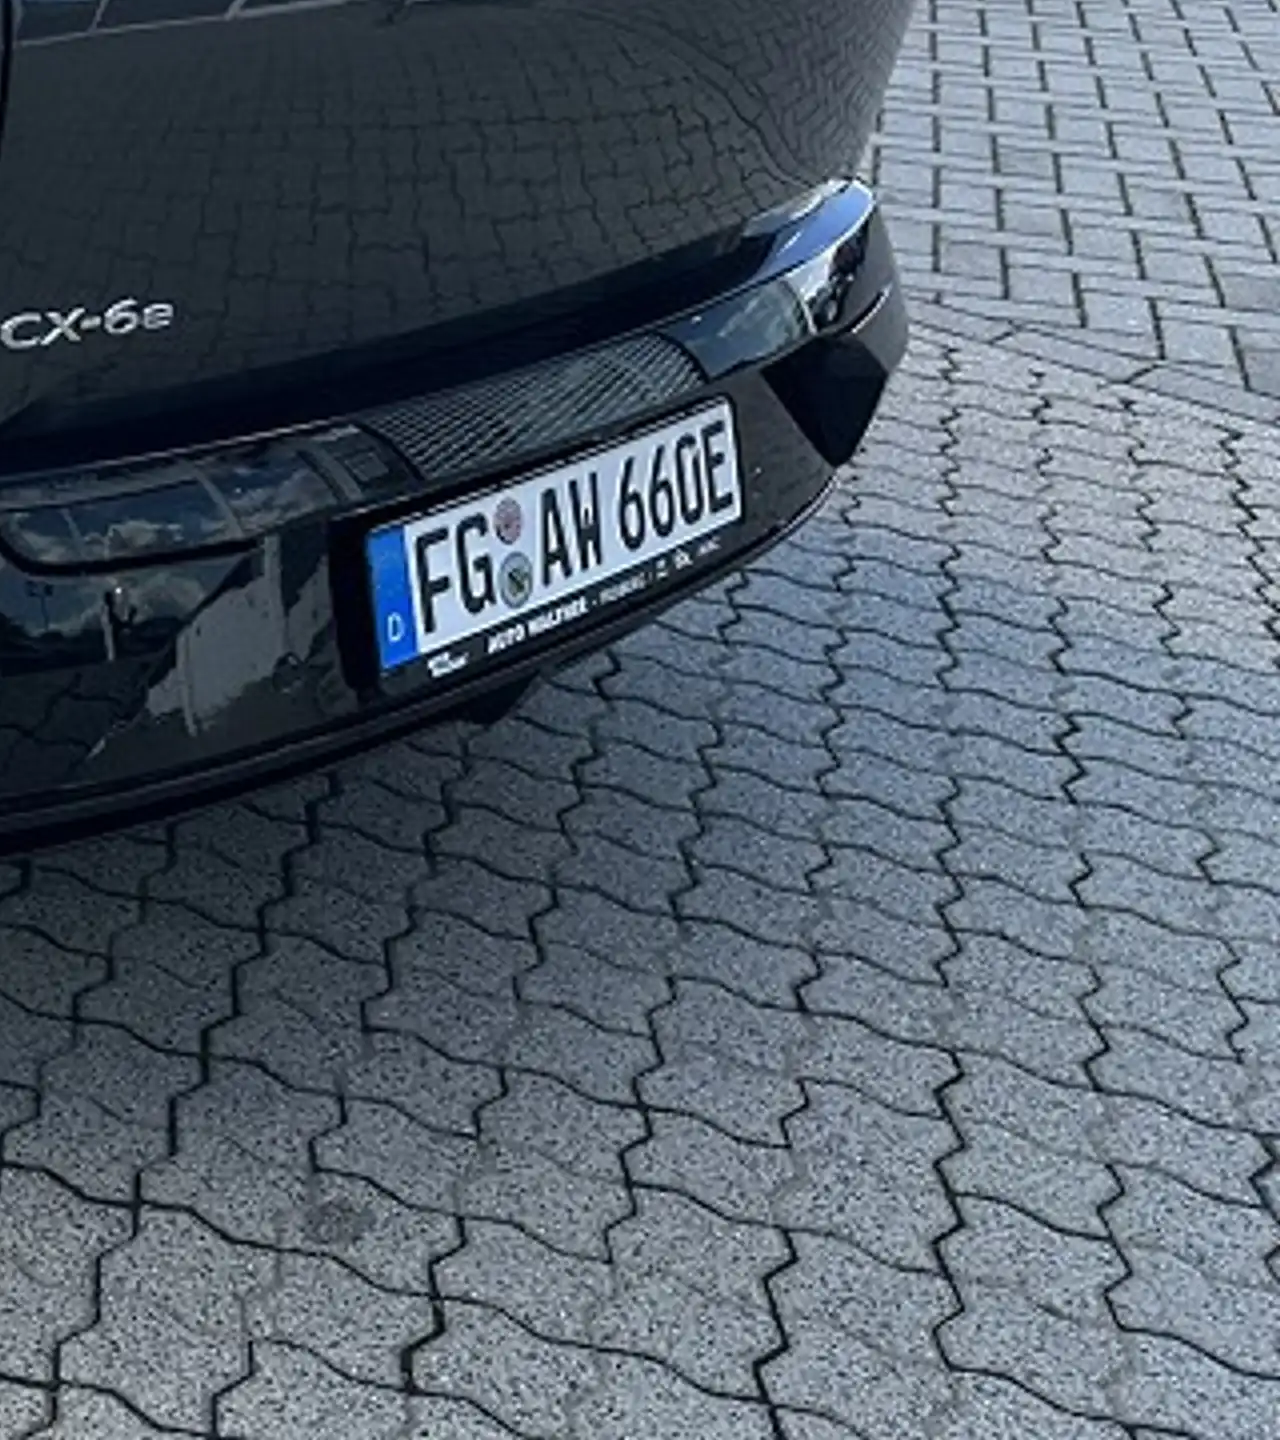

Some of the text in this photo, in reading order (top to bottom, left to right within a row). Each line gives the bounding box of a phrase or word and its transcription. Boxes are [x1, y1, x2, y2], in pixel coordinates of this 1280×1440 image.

[0, 297, 175, 350] CX-6e
[389, 613, 406, 642] D
[413, 512, 498, 635] FG
[540, 471, 603, 587] AW
[617, 419, 735, 551] 660E
